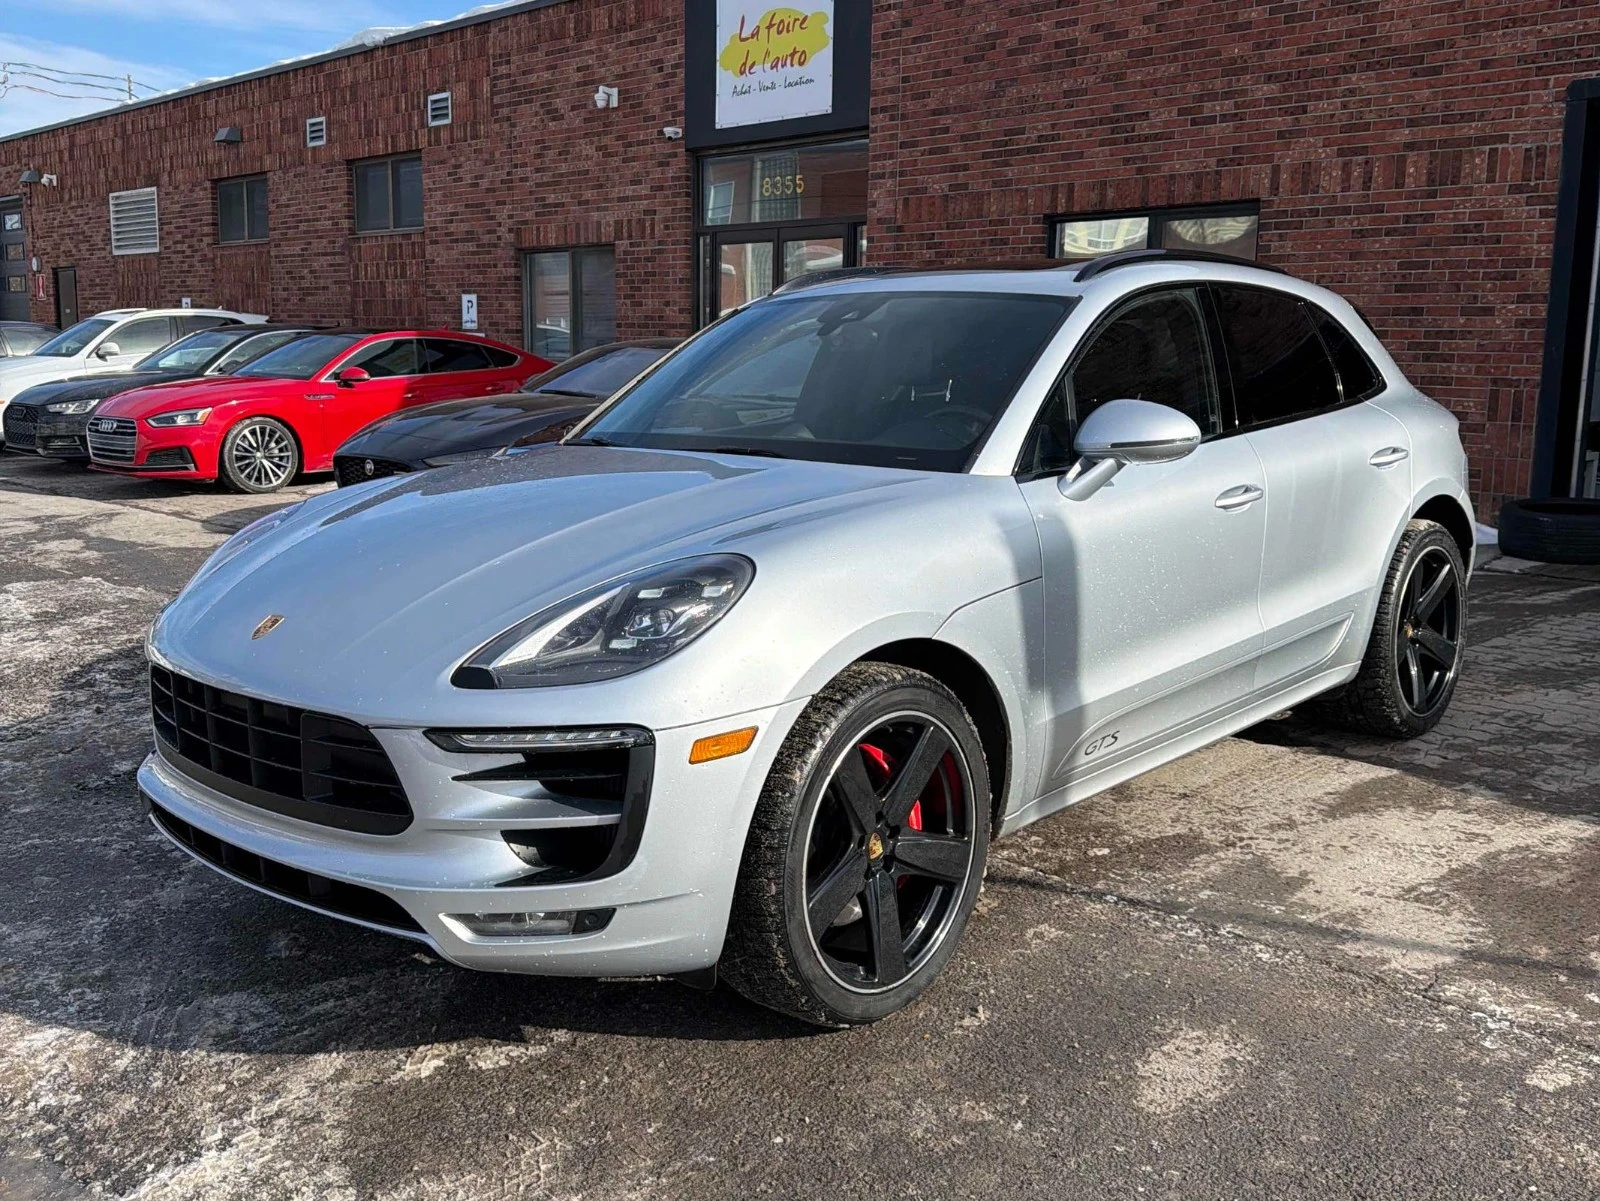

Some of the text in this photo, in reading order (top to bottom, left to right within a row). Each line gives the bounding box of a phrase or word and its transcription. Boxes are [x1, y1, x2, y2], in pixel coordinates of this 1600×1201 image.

[739, 12, 809, 44] La foire
[739, 46, 807, 77] de l'auto
[732, 83, 752, 97] Achat
[758, 80, 777, 93] Vente
[783, 76, 815, 89] Location
[762, 174, 805, 197] 8355
[467, 299, 474, 315] P
[1084, 729, 1120, 756] GTS
